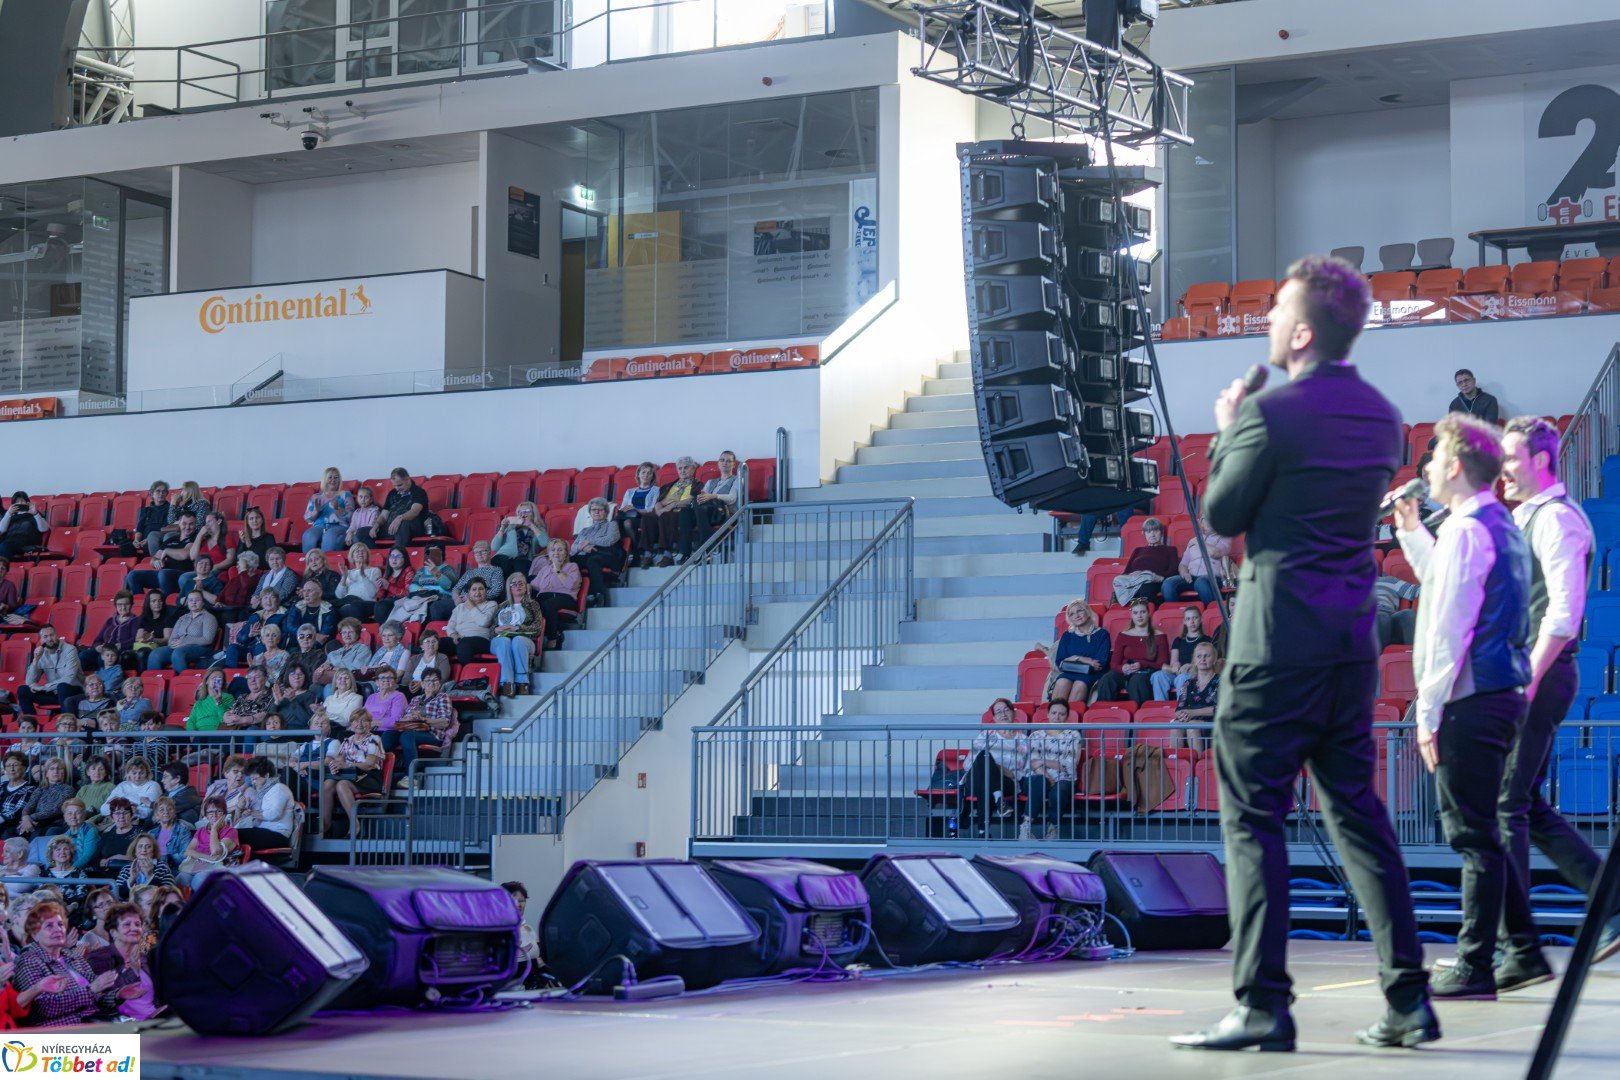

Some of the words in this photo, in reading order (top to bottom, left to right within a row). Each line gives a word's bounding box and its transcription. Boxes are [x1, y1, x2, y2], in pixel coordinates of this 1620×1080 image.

[1507, 295, 1557, 307] Eissmann
[199, 287, 348, 334] Continental
[1243, 313, 1270, 324] Eissm
[626, 358, 686, 375] Continental
[731, 350, 790, 369] Continental
[526, 366, 583, 383] Continental
[0, 403, 34, 415] tinental
[80, 399, 119, 410] ntinental
